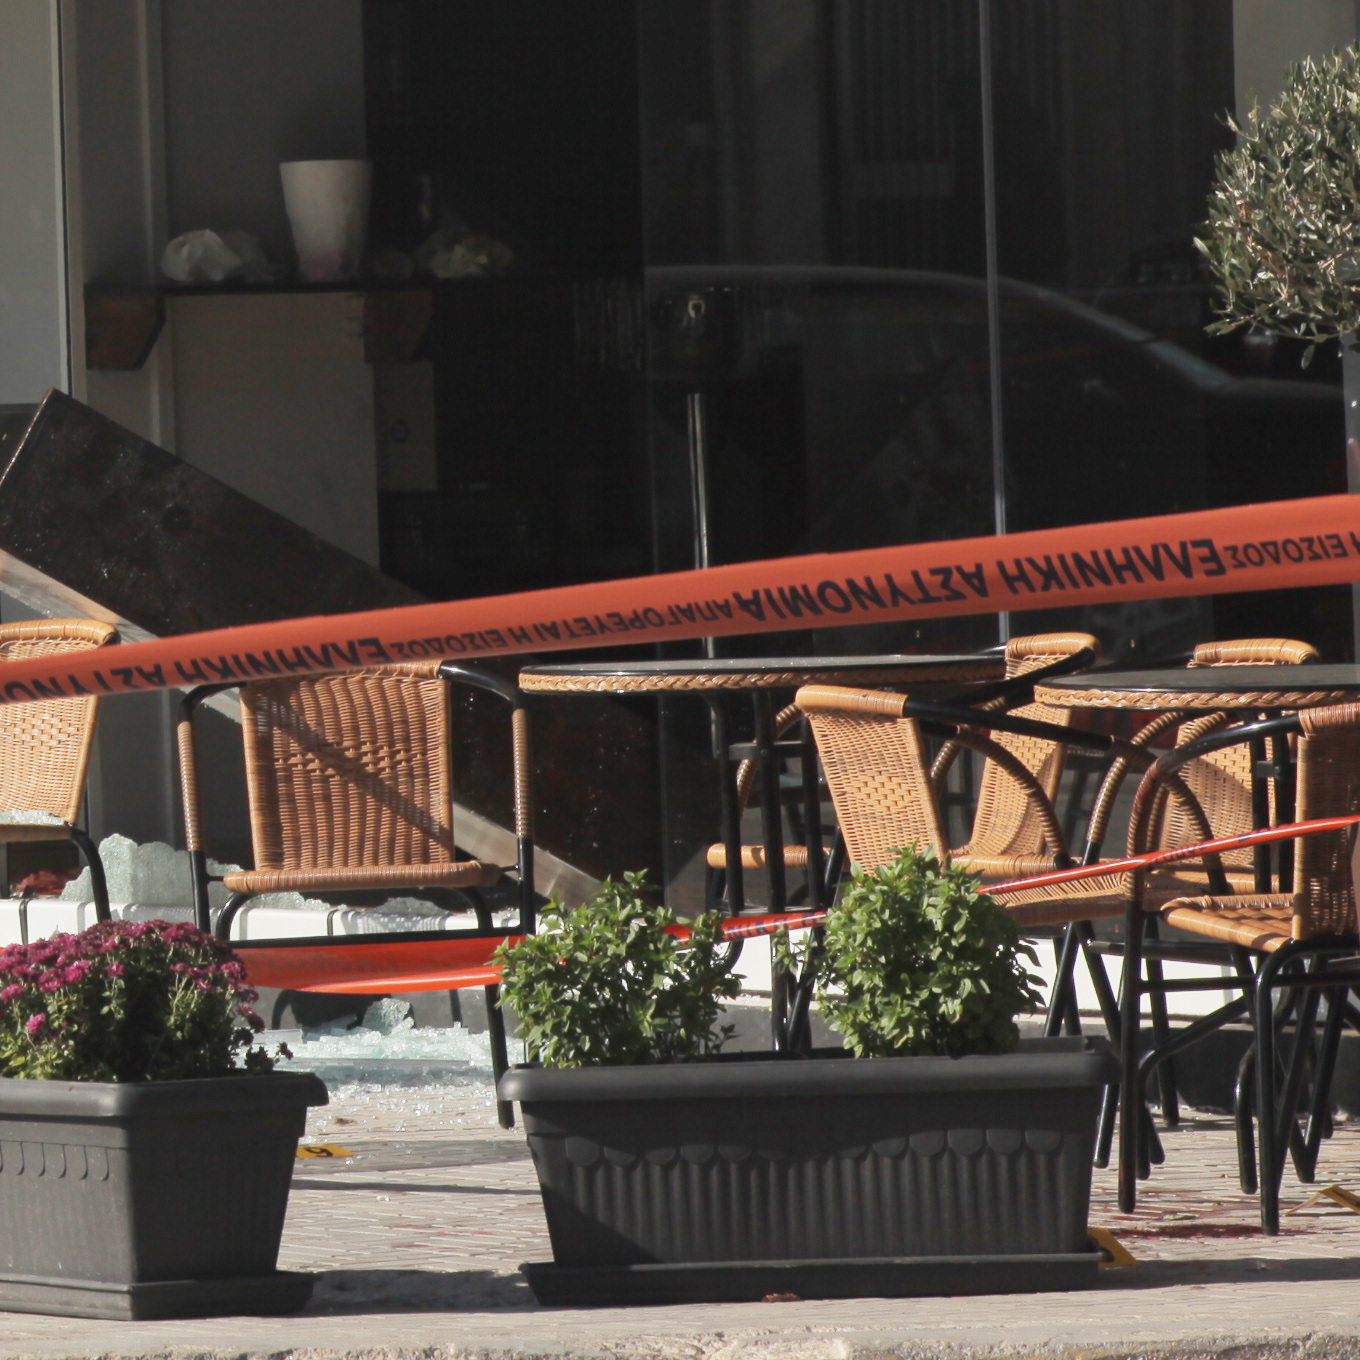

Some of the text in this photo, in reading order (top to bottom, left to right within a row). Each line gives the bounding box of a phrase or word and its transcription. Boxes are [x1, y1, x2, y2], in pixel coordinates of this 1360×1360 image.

[997, 539, 1227, 595] ΕΛΛΗΝΙΚΗ
[1226, 532, 1349, 568] ΕΙΣΟΔΟΣ
[734, 562, 989, 621] ΑΣΤΥΝΟΜΙΑ
[393, 630, 506, 657] ΕΙΣΟΔΟΣ
[535, 598, 734, 646] ΑΠΑΓΟΡΕΥΕΤΑΙ
[178, 638, 388, 685] ΕΛΛΗΝΙΚΗ
